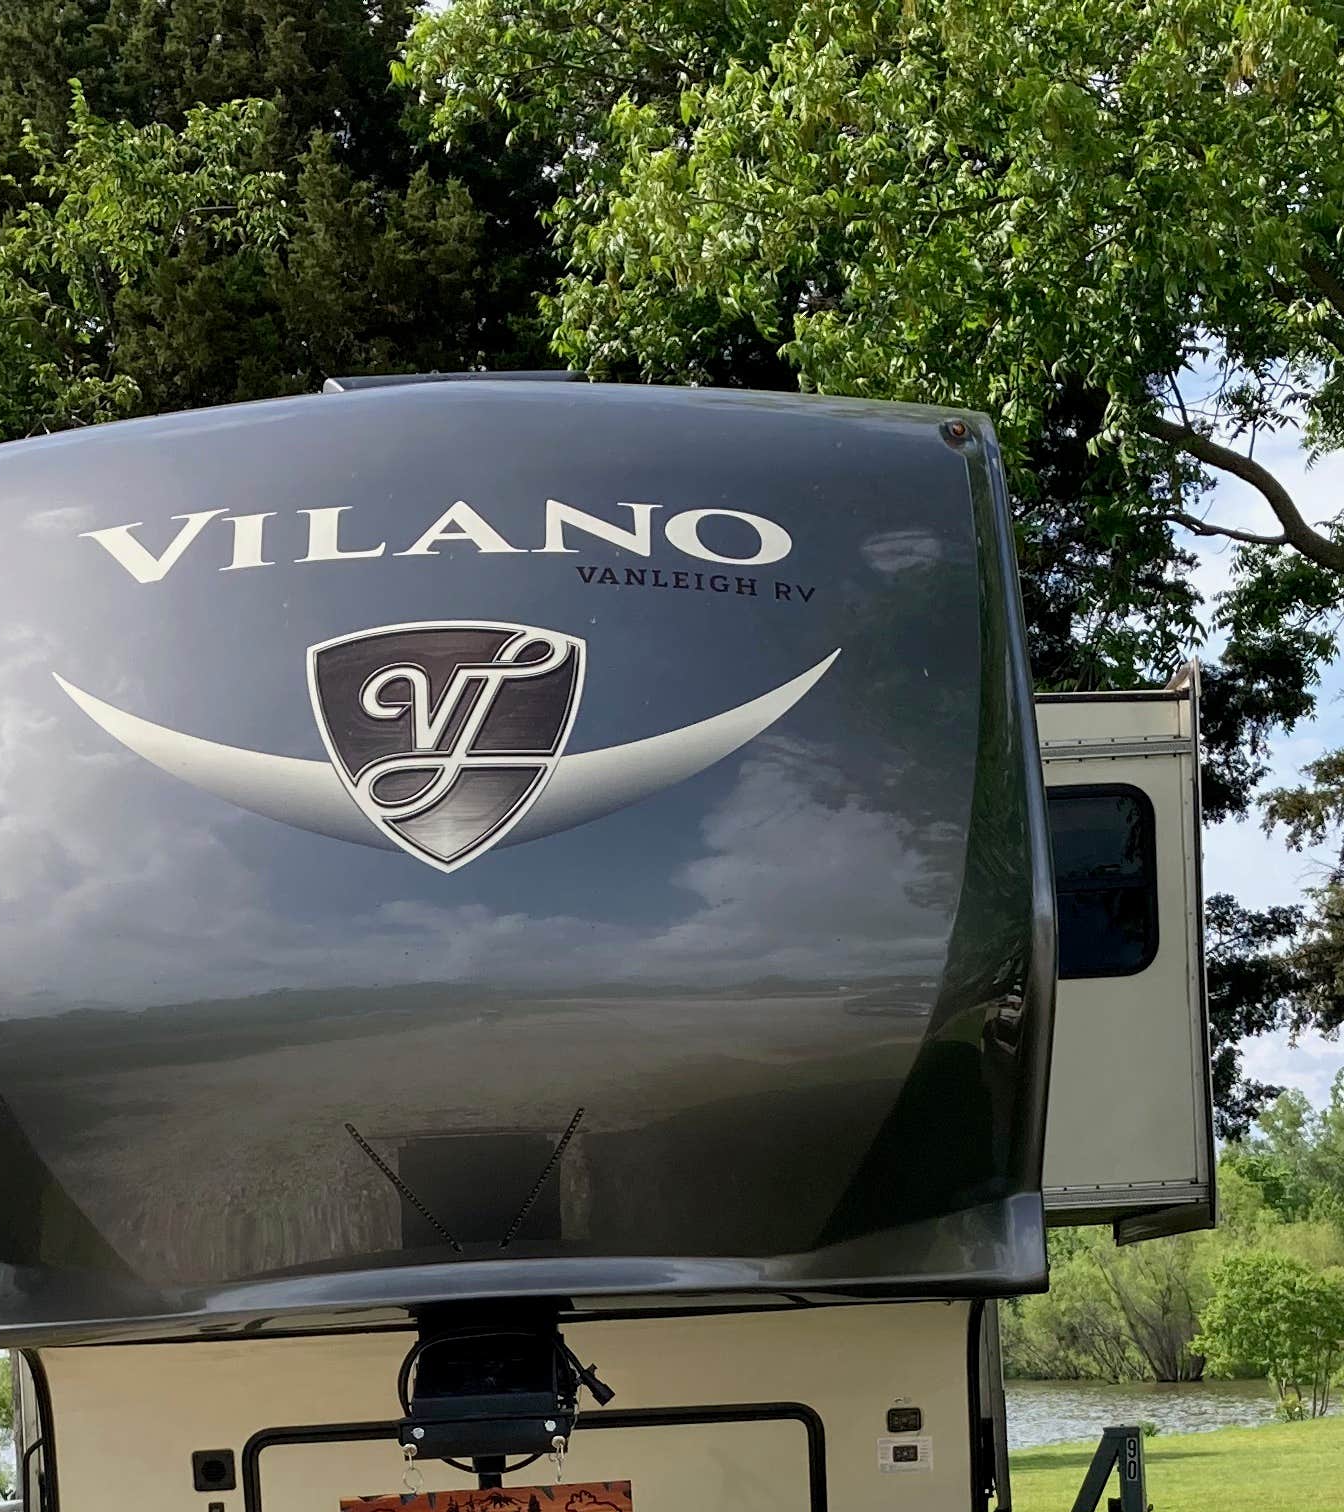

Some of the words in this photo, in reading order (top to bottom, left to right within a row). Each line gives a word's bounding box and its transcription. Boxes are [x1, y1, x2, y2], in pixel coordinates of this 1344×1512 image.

[79, 498, 793, 584] VILANO
[575, 566, 758, 597] VANLEIGH
[774, 581, 816, 603] RV
[1127, 1438, 1137, 1480] 90
